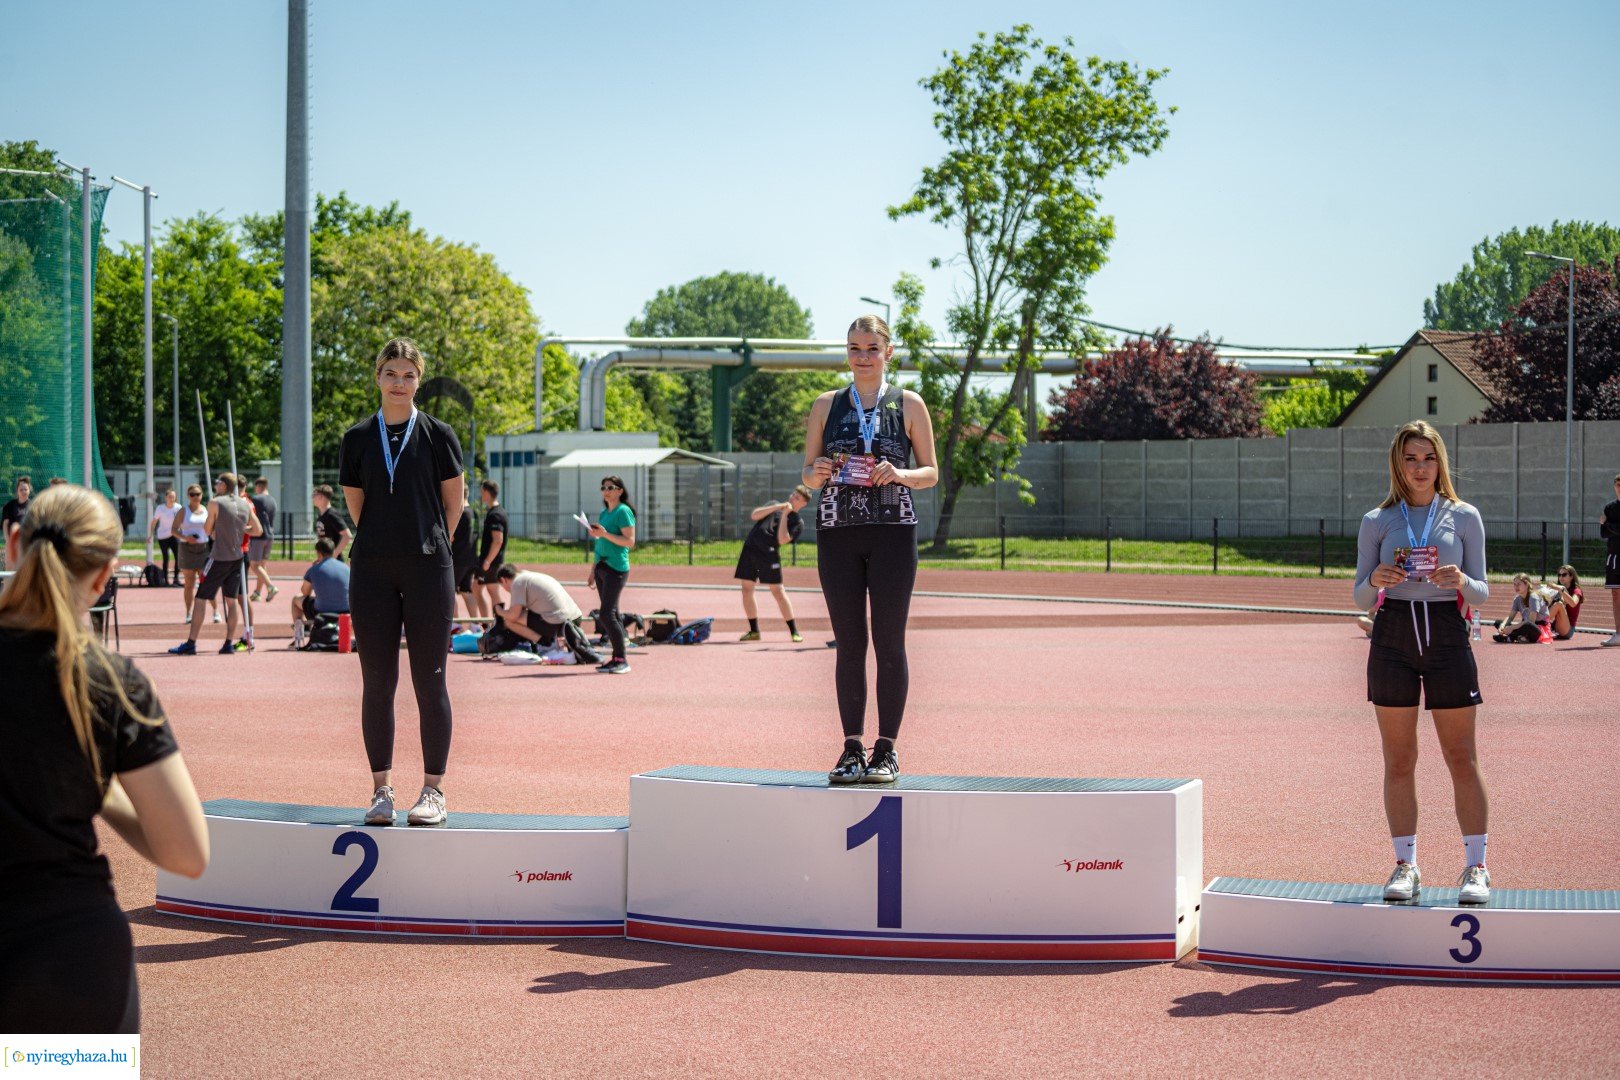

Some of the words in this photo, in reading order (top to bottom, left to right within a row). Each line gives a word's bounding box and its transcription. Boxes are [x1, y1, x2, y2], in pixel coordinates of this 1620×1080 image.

[331, 830, 379, 912] 2
[526, 870, 573, 884] polanik
[846, 796, 902, 929] 1
[1075, 859, 1124, 873] polanik
[1449, 913, 1482, 964] 3
